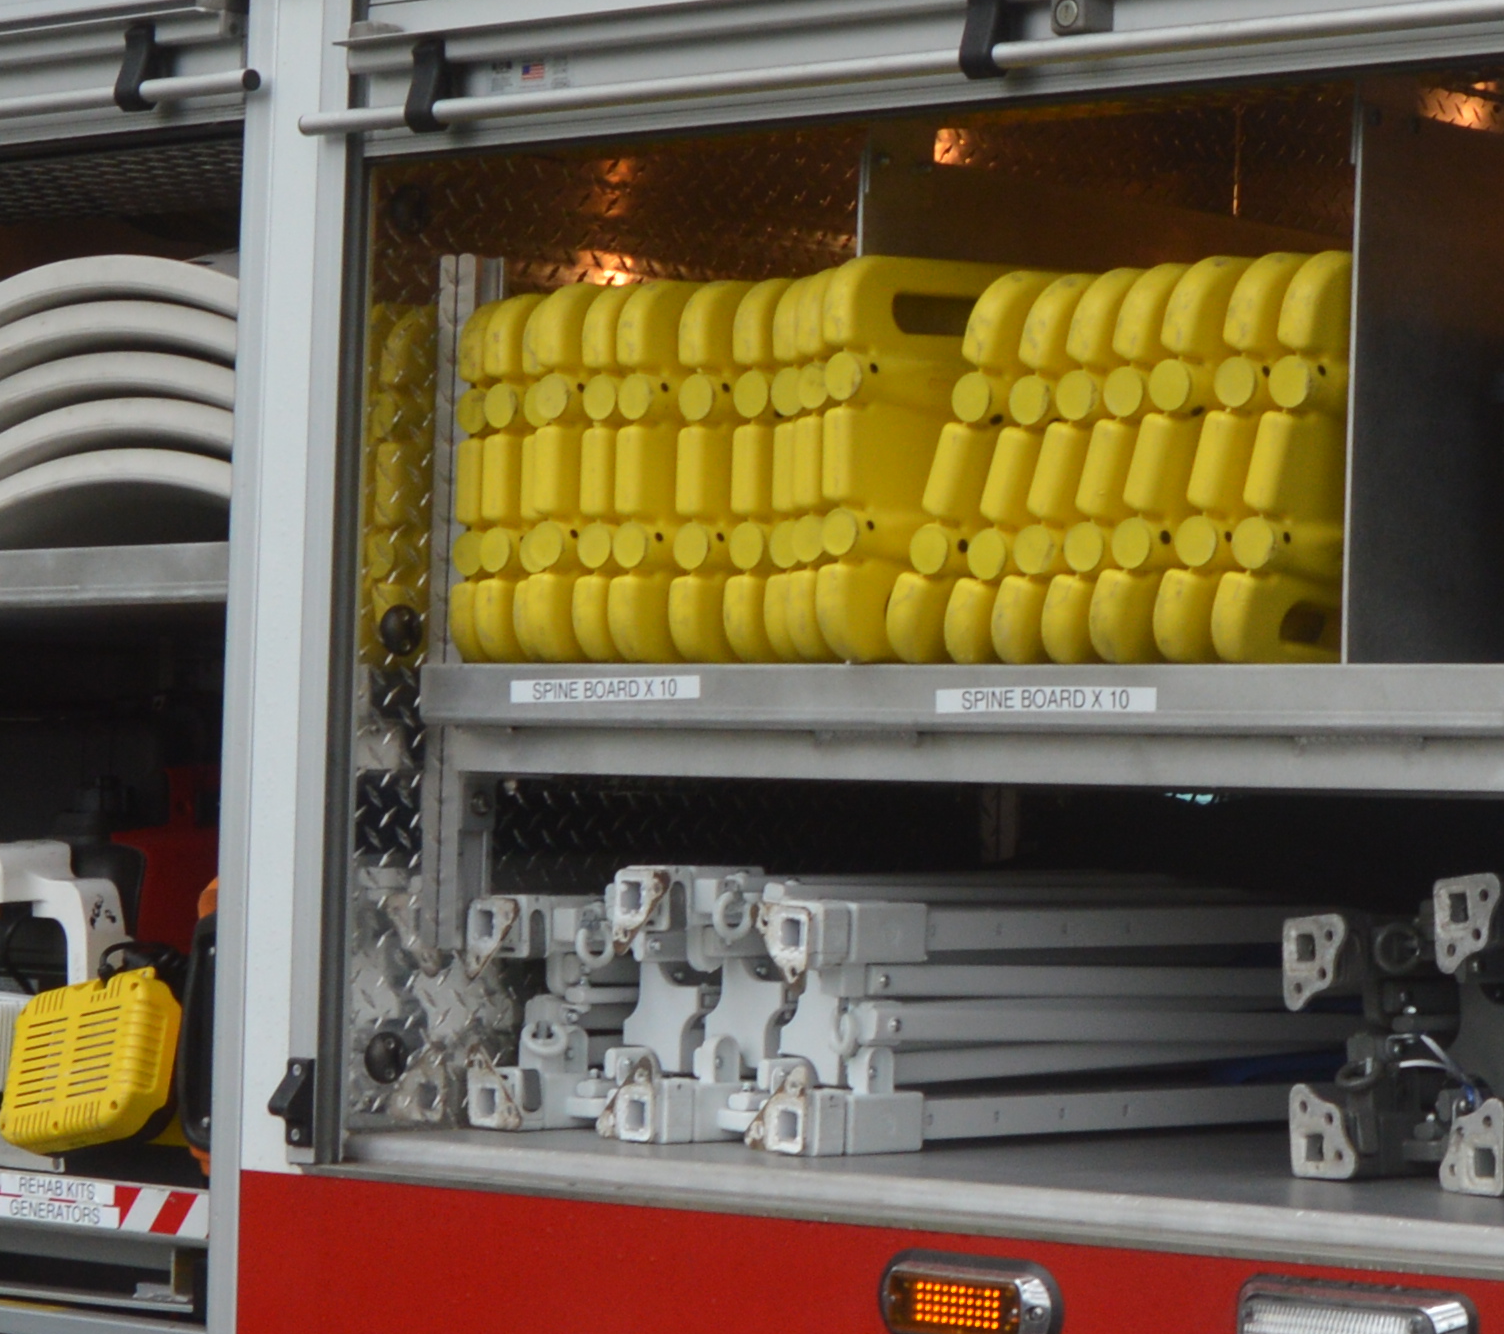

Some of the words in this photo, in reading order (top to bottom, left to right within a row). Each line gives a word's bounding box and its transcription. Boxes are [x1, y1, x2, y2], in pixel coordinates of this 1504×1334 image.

[532, 681, 579, 700] SPINE
[583, 680, 640, 700] BOARD
[644, 680, 654, 697] X
[660, 678, 678, 697] 10
[961, 689, 1015, 710] SPINE
[1020, 689, 1086, 709] BOARD
[1091, 689, 1103, 709] X
[1110, 689, 1130, 709] 10
[18, 1176, 64, 1197] REHAB
[67, 1181, 95, 1201] KITS
[10, 1199, 101, 1225] GENERATORS
